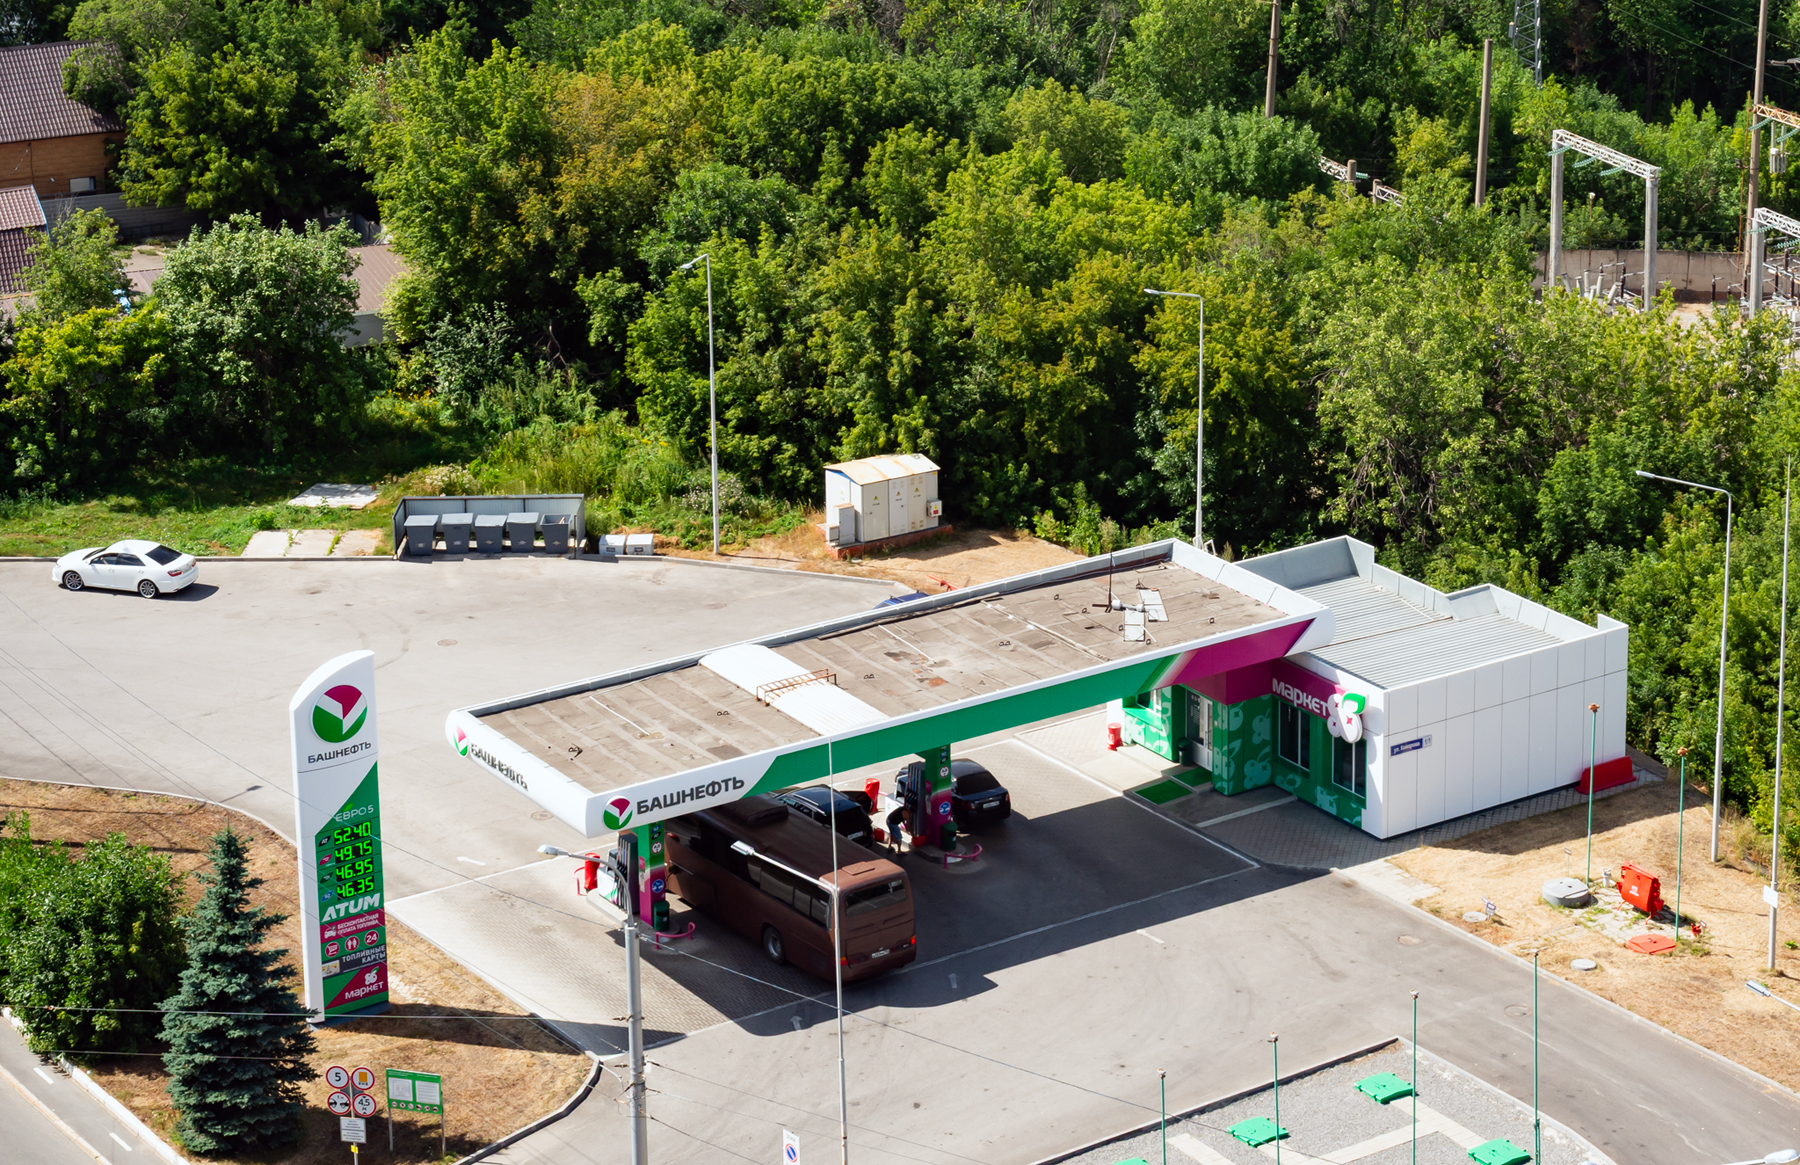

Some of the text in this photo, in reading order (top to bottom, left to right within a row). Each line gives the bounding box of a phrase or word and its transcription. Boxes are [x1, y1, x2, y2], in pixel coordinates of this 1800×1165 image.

[308, 741, 372, 764] БАШНЕФТЬ
[636, 776, 745, 815] БАШНЕФТЬ
[335, 805, 374, 822] ЕВРО 5
[334, 822, 371, 844] 52.40
[335, 840, 372, 861] 49.75
[336, 858, 373, 879] 46.95
[337, 876, 374, 897] 46.35
[321, 893, 380, 923] ATUM
[337, 913, 379, 930] БЕСКОНТАКТНАЯ
[337, 919, 379, 934] ОПЛАТА ТОПЛИВА
[367, 934, 377, 943] 24
[342, 945, 385, 962] ТОПЛИВНЫЕ
[362, 952, 386, 963] КАРТЫ
[334, 1072, 341, 1081] 5
[358, 1099, 370, 1107] 4,5
